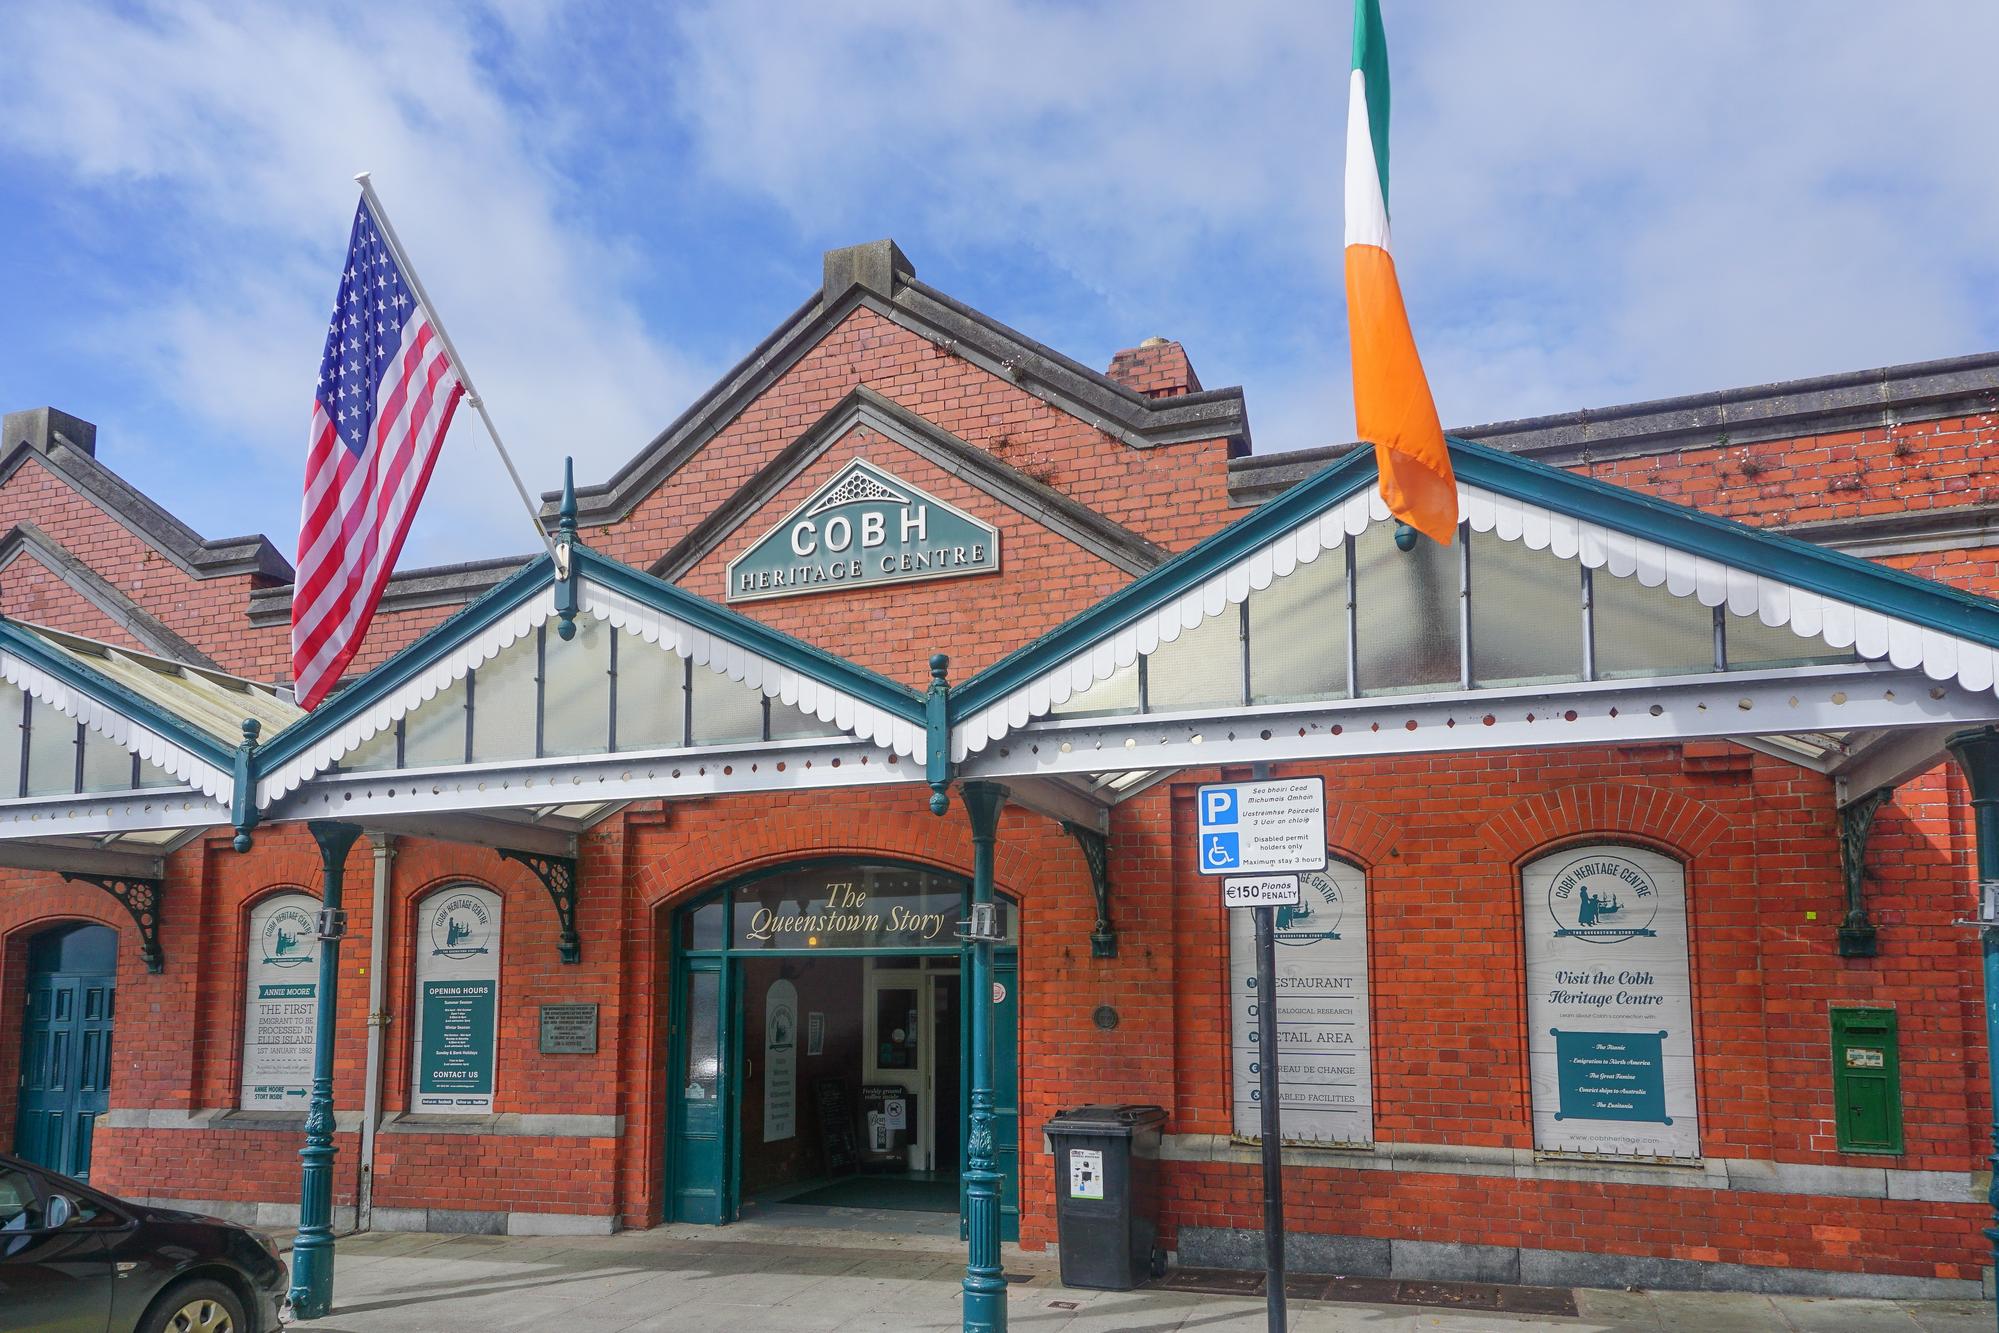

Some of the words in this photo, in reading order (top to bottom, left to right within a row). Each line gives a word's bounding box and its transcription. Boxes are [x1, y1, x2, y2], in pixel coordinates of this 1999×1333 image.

[791, 505, 927, 557] COBH
[741, 559, 862, 591] HERITAGE
[880, 545, 984, 573] CENTRE
[1207, 792, 1231, 823] P
[1286, 834, 1309, 842] permit
[1555, 875, 1577, 899] COBH
[1573, 863, 1620, 880] HERITAGE
[1620, 868, 1651, 898] CENTRE
[825, 882, 867, 908] The
[1227, 885, 1259, 898] €150
[1261, 882, 1291, 890] Pionos
[1262, 891, 1297, 899] PENALTY
[1311, 876, 1338, 904] CENTRE
[436, 909, 449, 927] COBH
[447, 899, 473, 913] HERITAGE
[472, 904, 488, 925] CENTRE
[746, 908, 879, 940] Queenstown
[886, 905, 945, 940] Story
[1275, 977, 1353, 988] ESTAURANT
[1555, 971, 1590, 985] Visit
[1592, 971, 1615, 985] the
[1618, 971, 1654, 985] Cobh
[429, 987, 461, 995] OPENING
[1548, 990, 1613, 1008] Heritage
[1616, 991, 1664, 1005] Centre
[260, 1004, 281, 1015] THE
[284, 1004, 314, 1015] FIRST
[258, 1026, 302, 1034] PROCESSED
[305, 1026, 313, 1034] IN
[258, 1036, 280, 1044] ELLIS
[282, 1035, 313, 1044] ISLAND
[1276, 1032, 1312, 1043] ETAIL
[1316, 1032, 1354, 1043] AREA
[1317, 1066, 1355, 1074] CHANGE
[1599, 1087, 1613, 1095] ships
[1308, 1094, 1355, 1103] FACILITIES
[1569, 1135, 1660, 1144] www.cobhheritage.com
